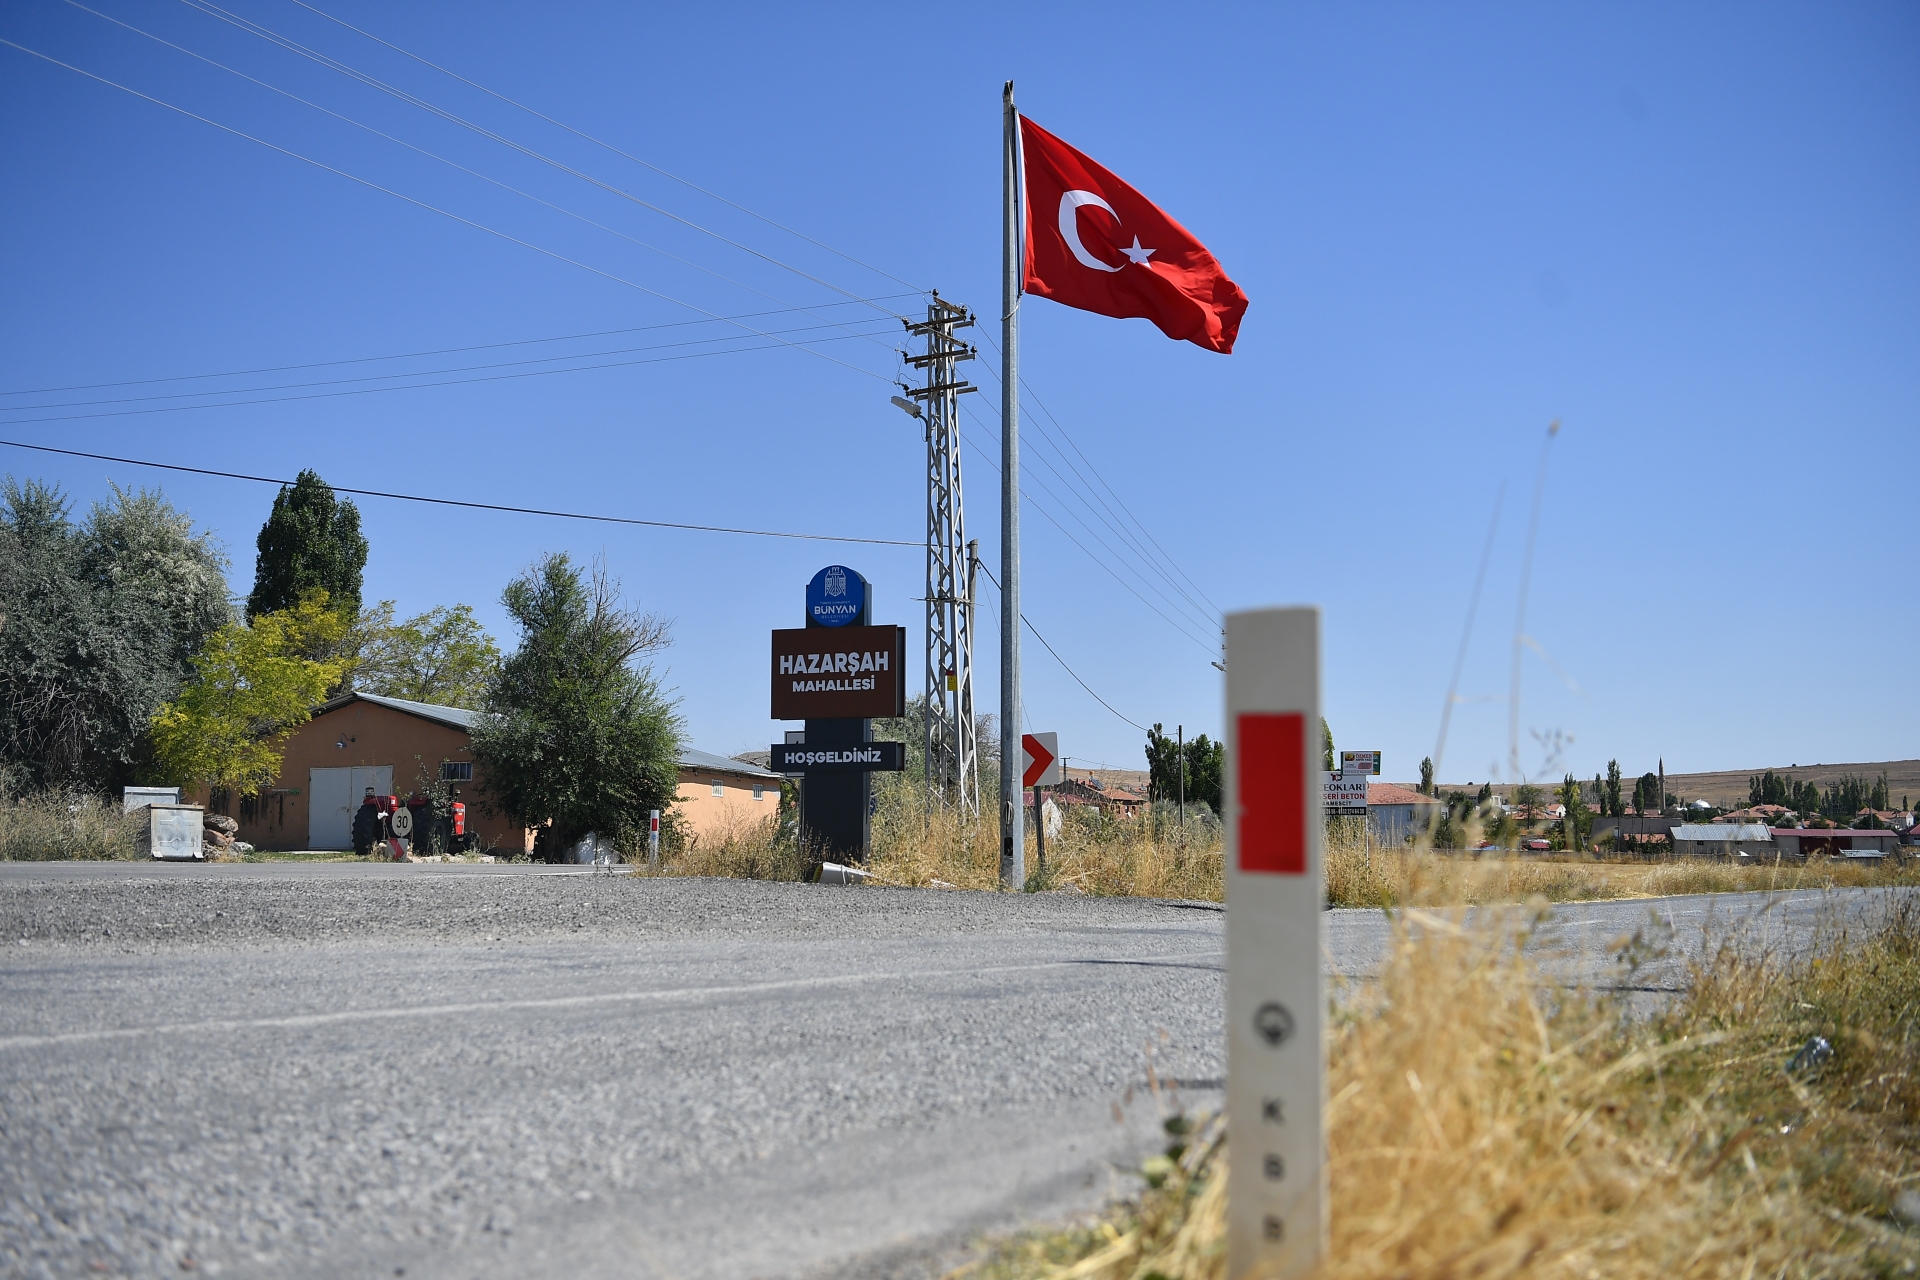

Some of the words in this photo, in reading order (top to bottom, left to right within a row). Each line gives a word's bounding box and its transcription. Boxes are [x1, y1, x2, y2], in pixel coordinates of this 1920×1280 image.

[814, 604, 856, 615] BÜNYAN
[779, 651, 889, 676] HAZARŞAH
[792, 674, 875, 692] MAHALLESİ
[784, 746, 882, 765] HOŞGELDİNİZ
[1341, 792, 1365, 800] BETON
[396, 815, 408, 829] 30
